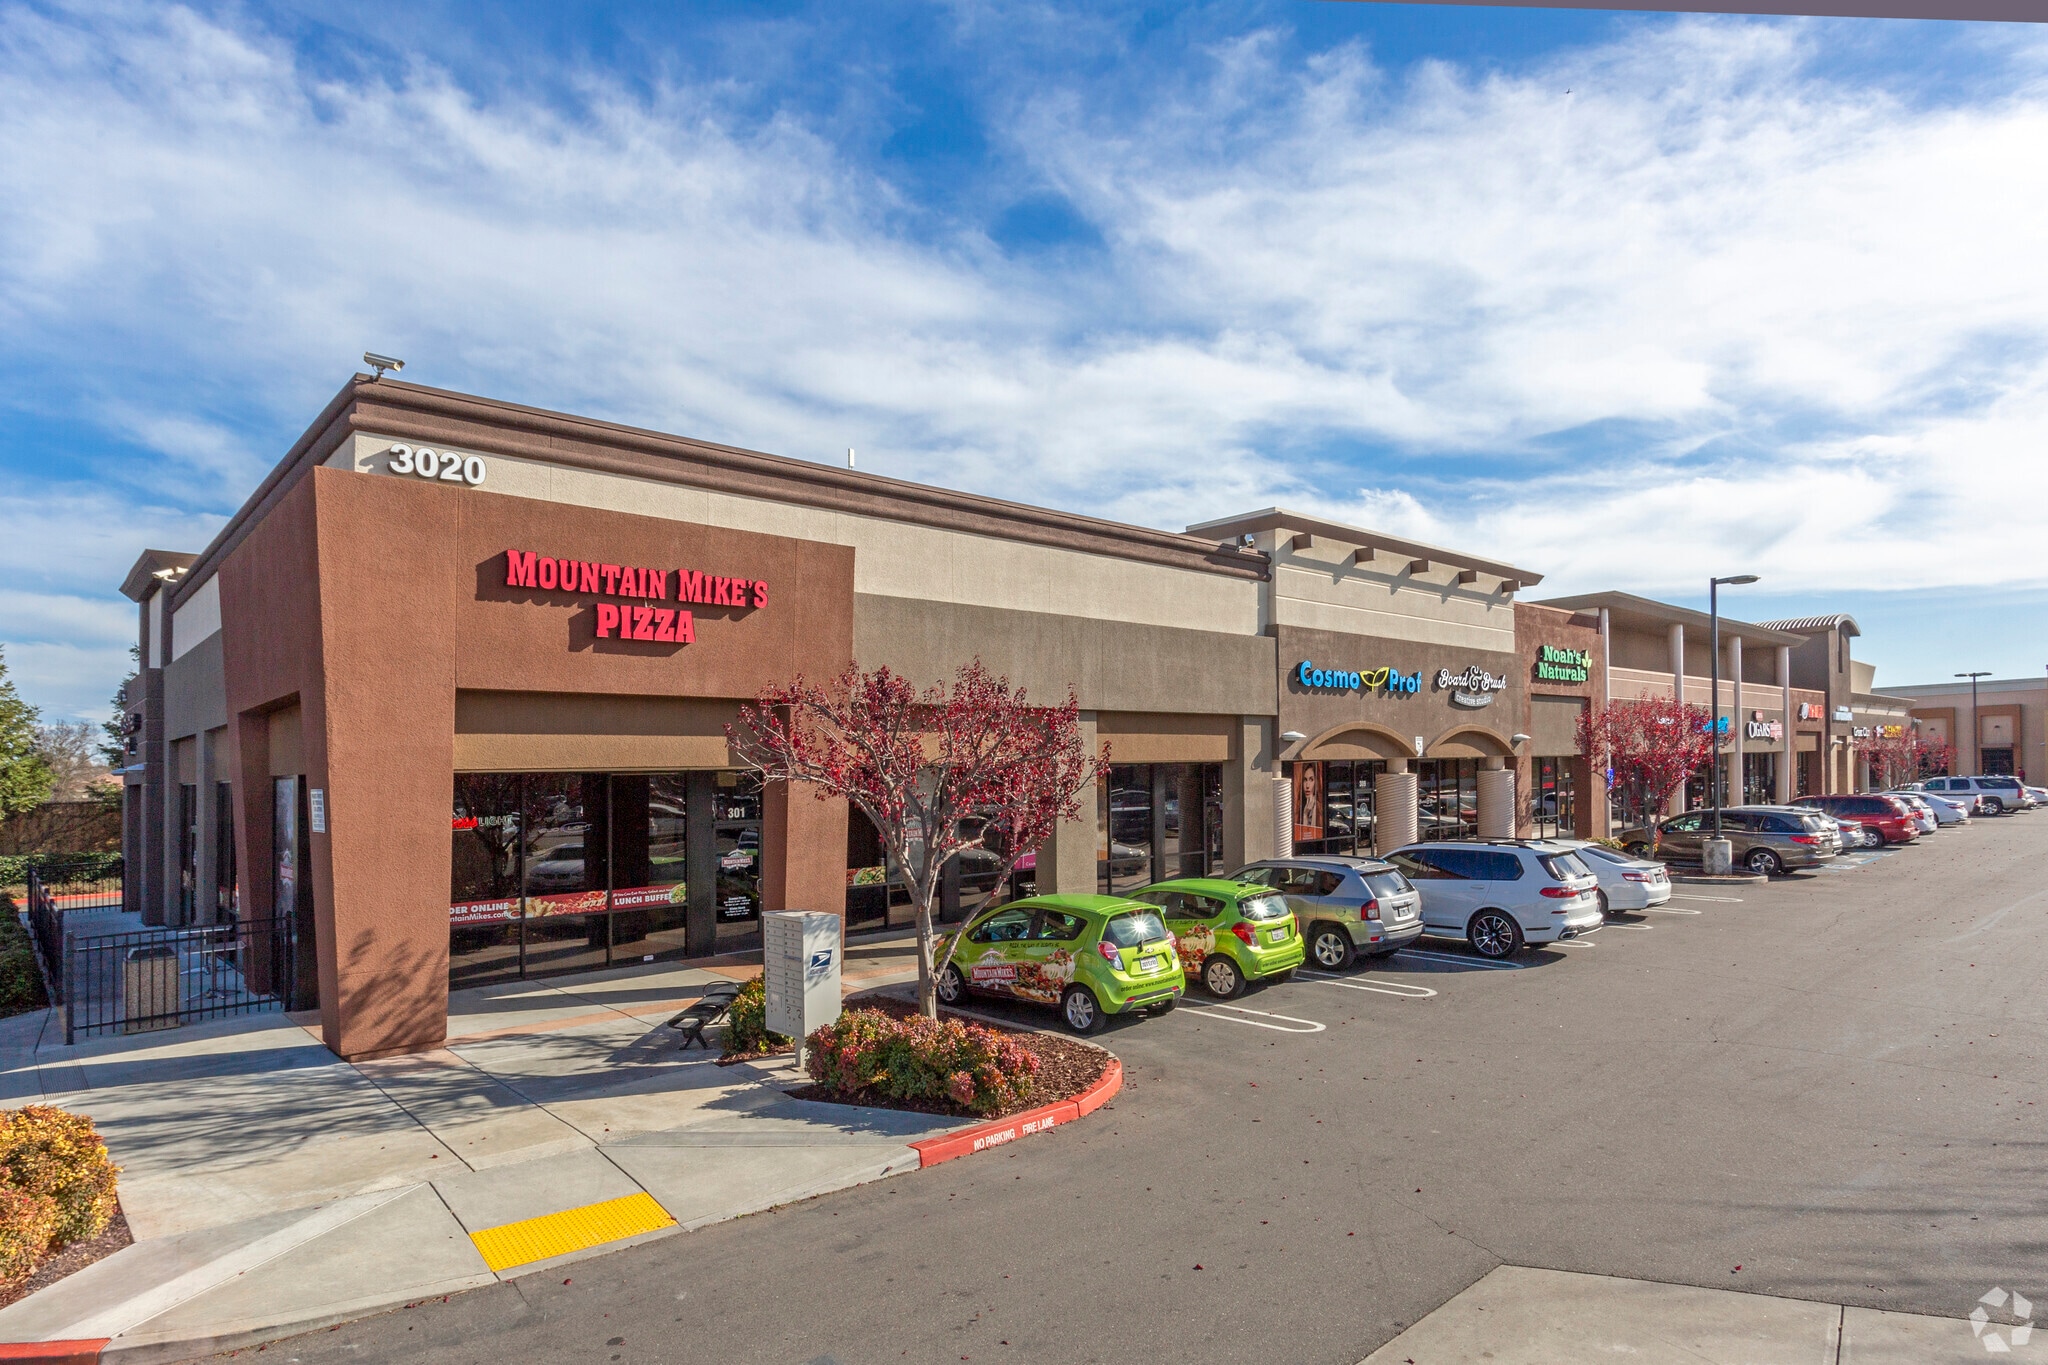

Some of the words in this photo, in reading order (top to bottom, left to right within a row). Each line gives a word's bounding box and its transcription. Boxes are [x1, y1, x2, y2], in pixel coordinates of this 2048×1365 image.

[388, 443, 486, 485] 3020
[506, 549, 668, 600] MOUNTAIN
[678, 569, 769, 608] MIKE'S
[596, 603, 696, 644] PIZZA
[1543, 645, 1582, 664] Noah's
[1300, 660, 1361, 690] Cosmo
[1389, 668, 1423, 694] Prof
[1438, 668, 1468, 688] Board
[1469, 665, 1482, 691] &
[1481, 672, 1507, 691] Brush
[1538, 661, 1587, 682] Naturals
[1456, 694, 1476, 705] creative
[1476, 695, 1491, 706] studio
[1749, 721, 1771, 738] CIGARS
[478, 815, 512, 827] LIGHT
[728, 808, 746, 818] 301
[470, 902, 509, 912] ONLINE
[614, 896, 642, 906] LUNCH
[645, 893, 672, 902] BUFFET
[973, 968, 997, 978] MOUNTAIN
[1022, 1123, 1038, 1135] FIRE
[1037, 1116, 1055, 1131] LANE
[974, 1137, 985, 1151] NO
[985, 1128, 1015, 1147] PARKING
